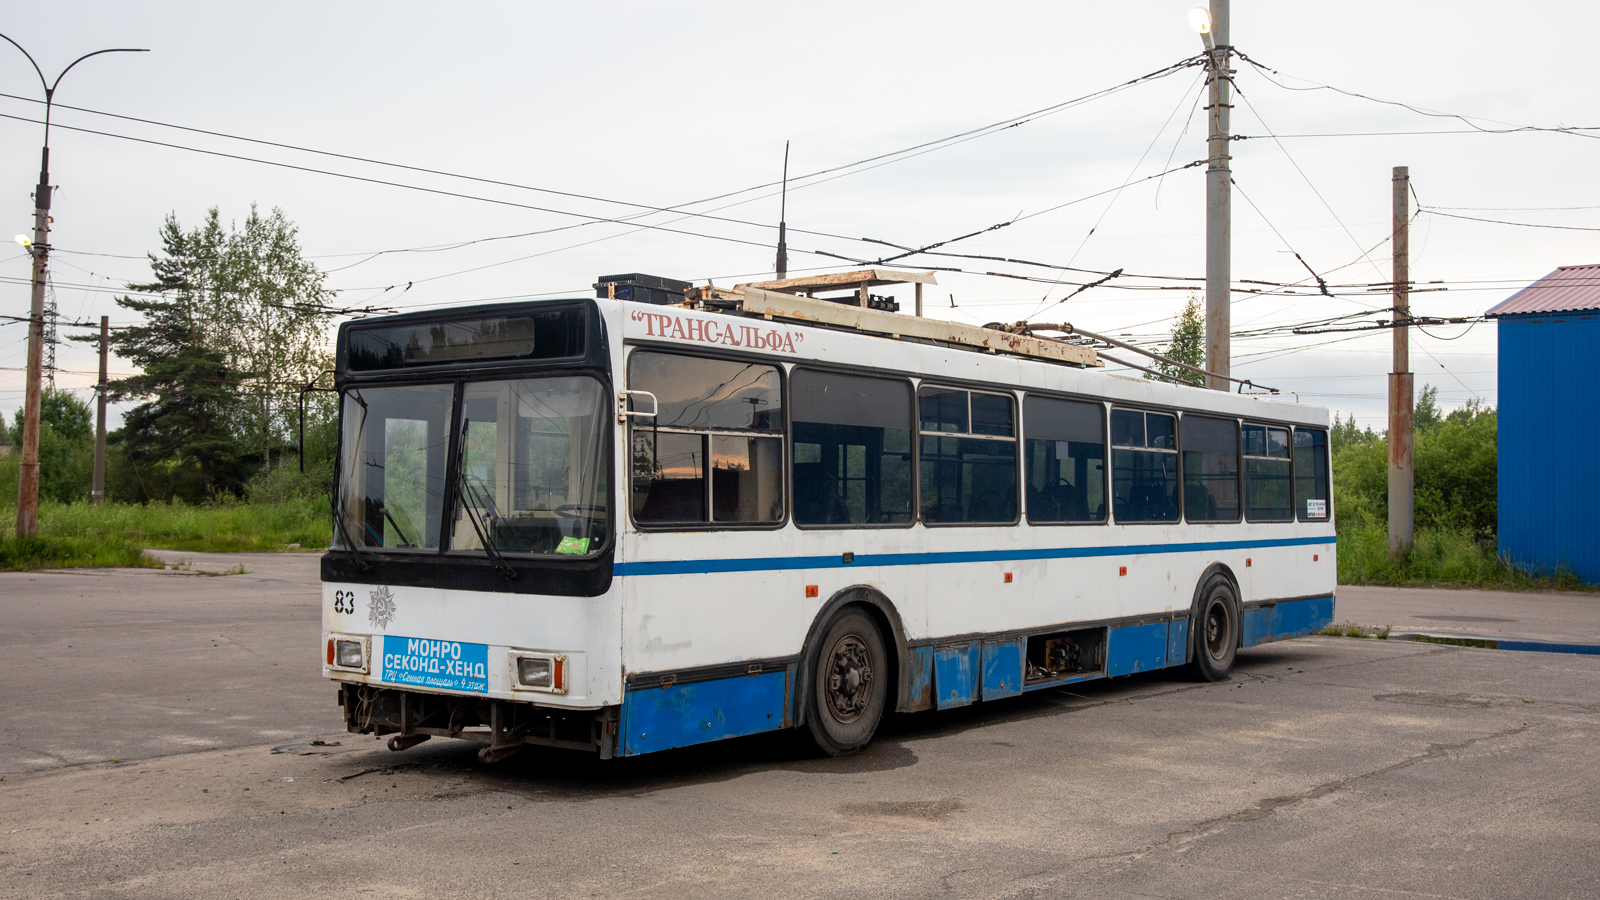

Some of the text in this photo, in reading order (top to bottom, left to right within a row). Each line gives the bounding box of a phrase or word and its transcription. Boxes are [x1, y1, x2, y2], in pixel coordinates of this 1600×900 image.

[334, 590, 354, 615] 83
[407, 638, 461, 660] МОНРО
[384, 653, 486, 678] СЕКОНД-ХЕНД
[385, 669, 397, 682] ТРЦ
[399, 672, 425, 683] «Сенная
[461, 678, 466, 688] 4
[467, 681, 485, 690] этаж
